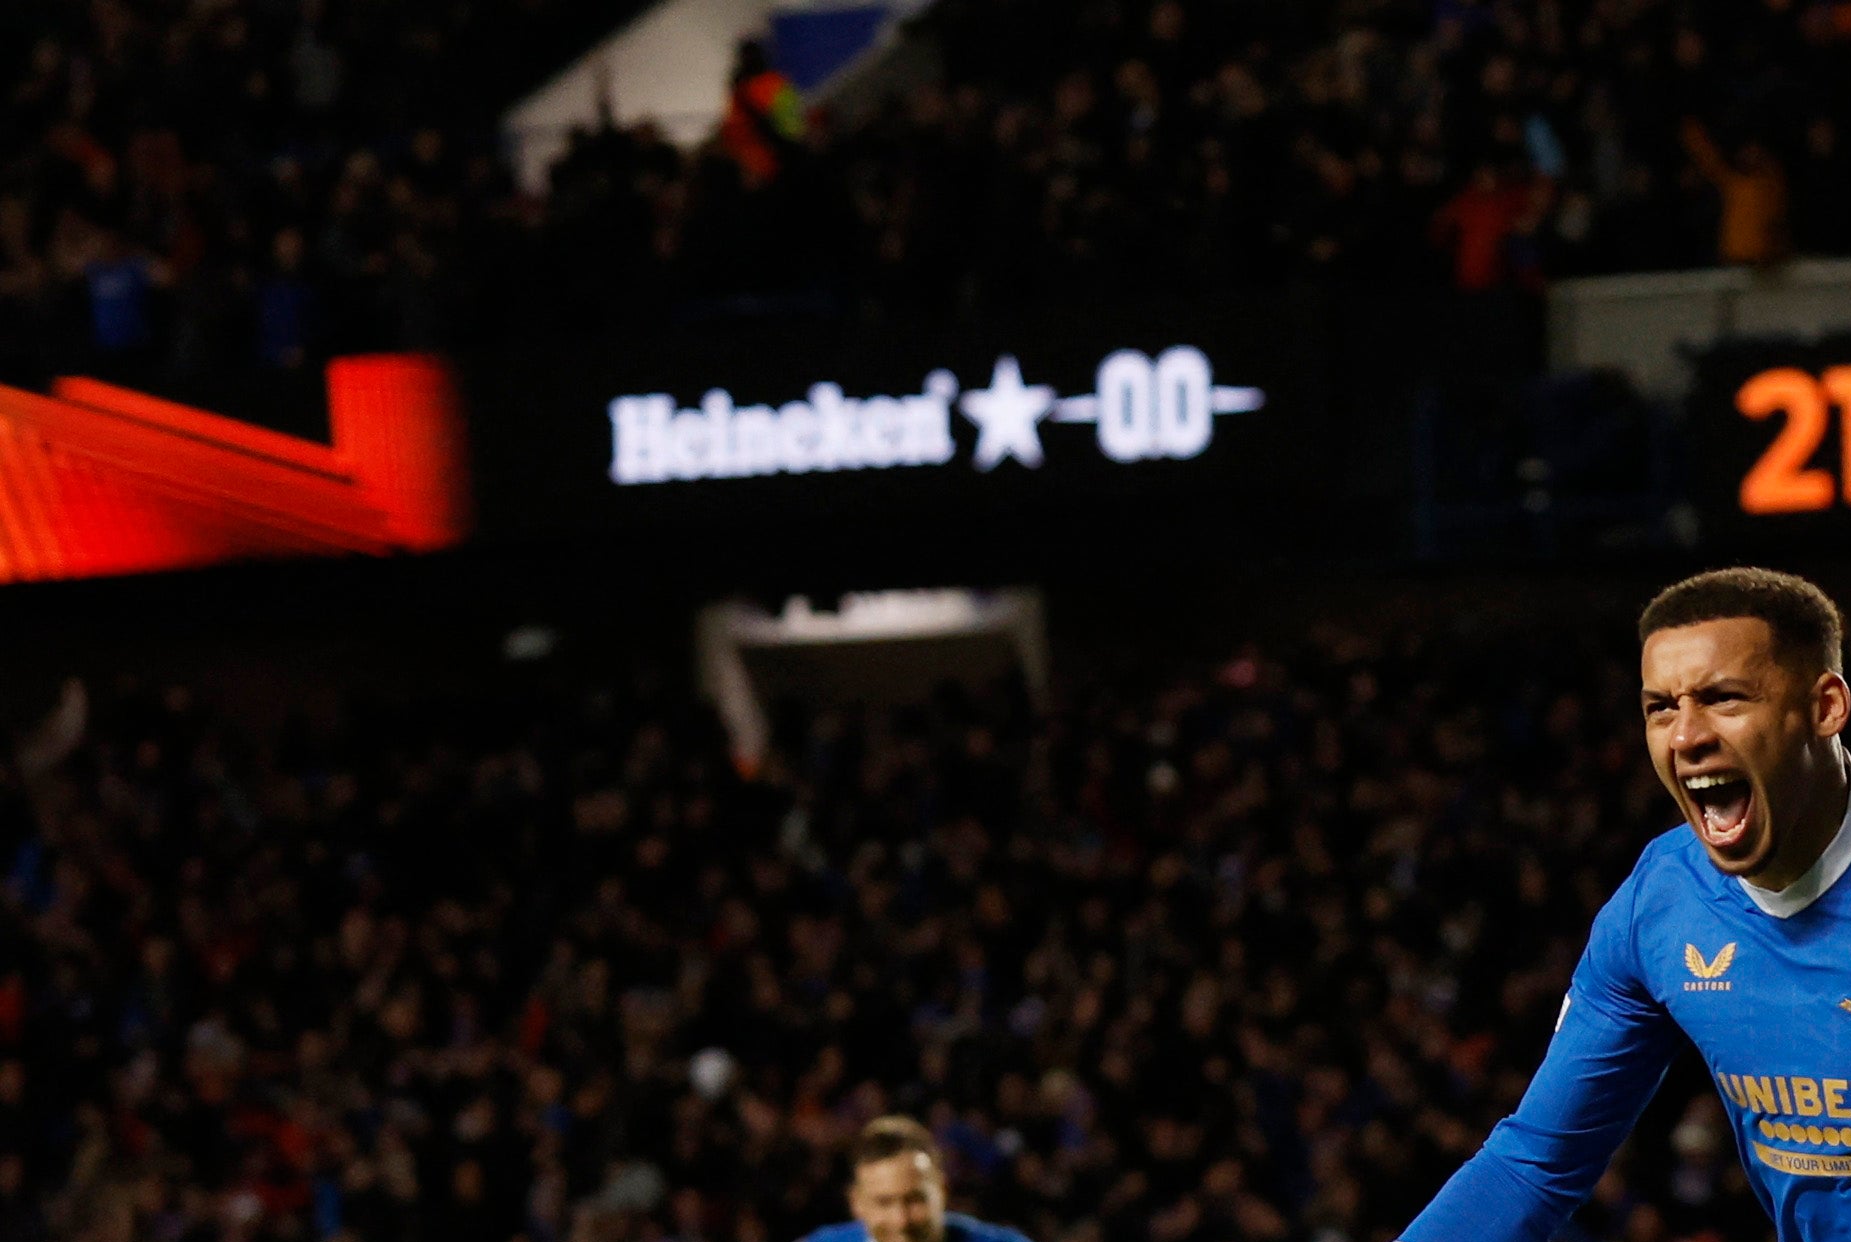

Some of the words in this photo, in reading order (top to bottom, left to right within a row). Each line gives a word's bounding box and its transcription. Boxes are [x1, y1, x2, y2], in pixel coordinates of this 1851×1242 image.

[608, 378, 956, 486] Heineken
[1683, 981, 1732, 991] CASTORE
[1785, 1156, 1820, 1171] YOUR
